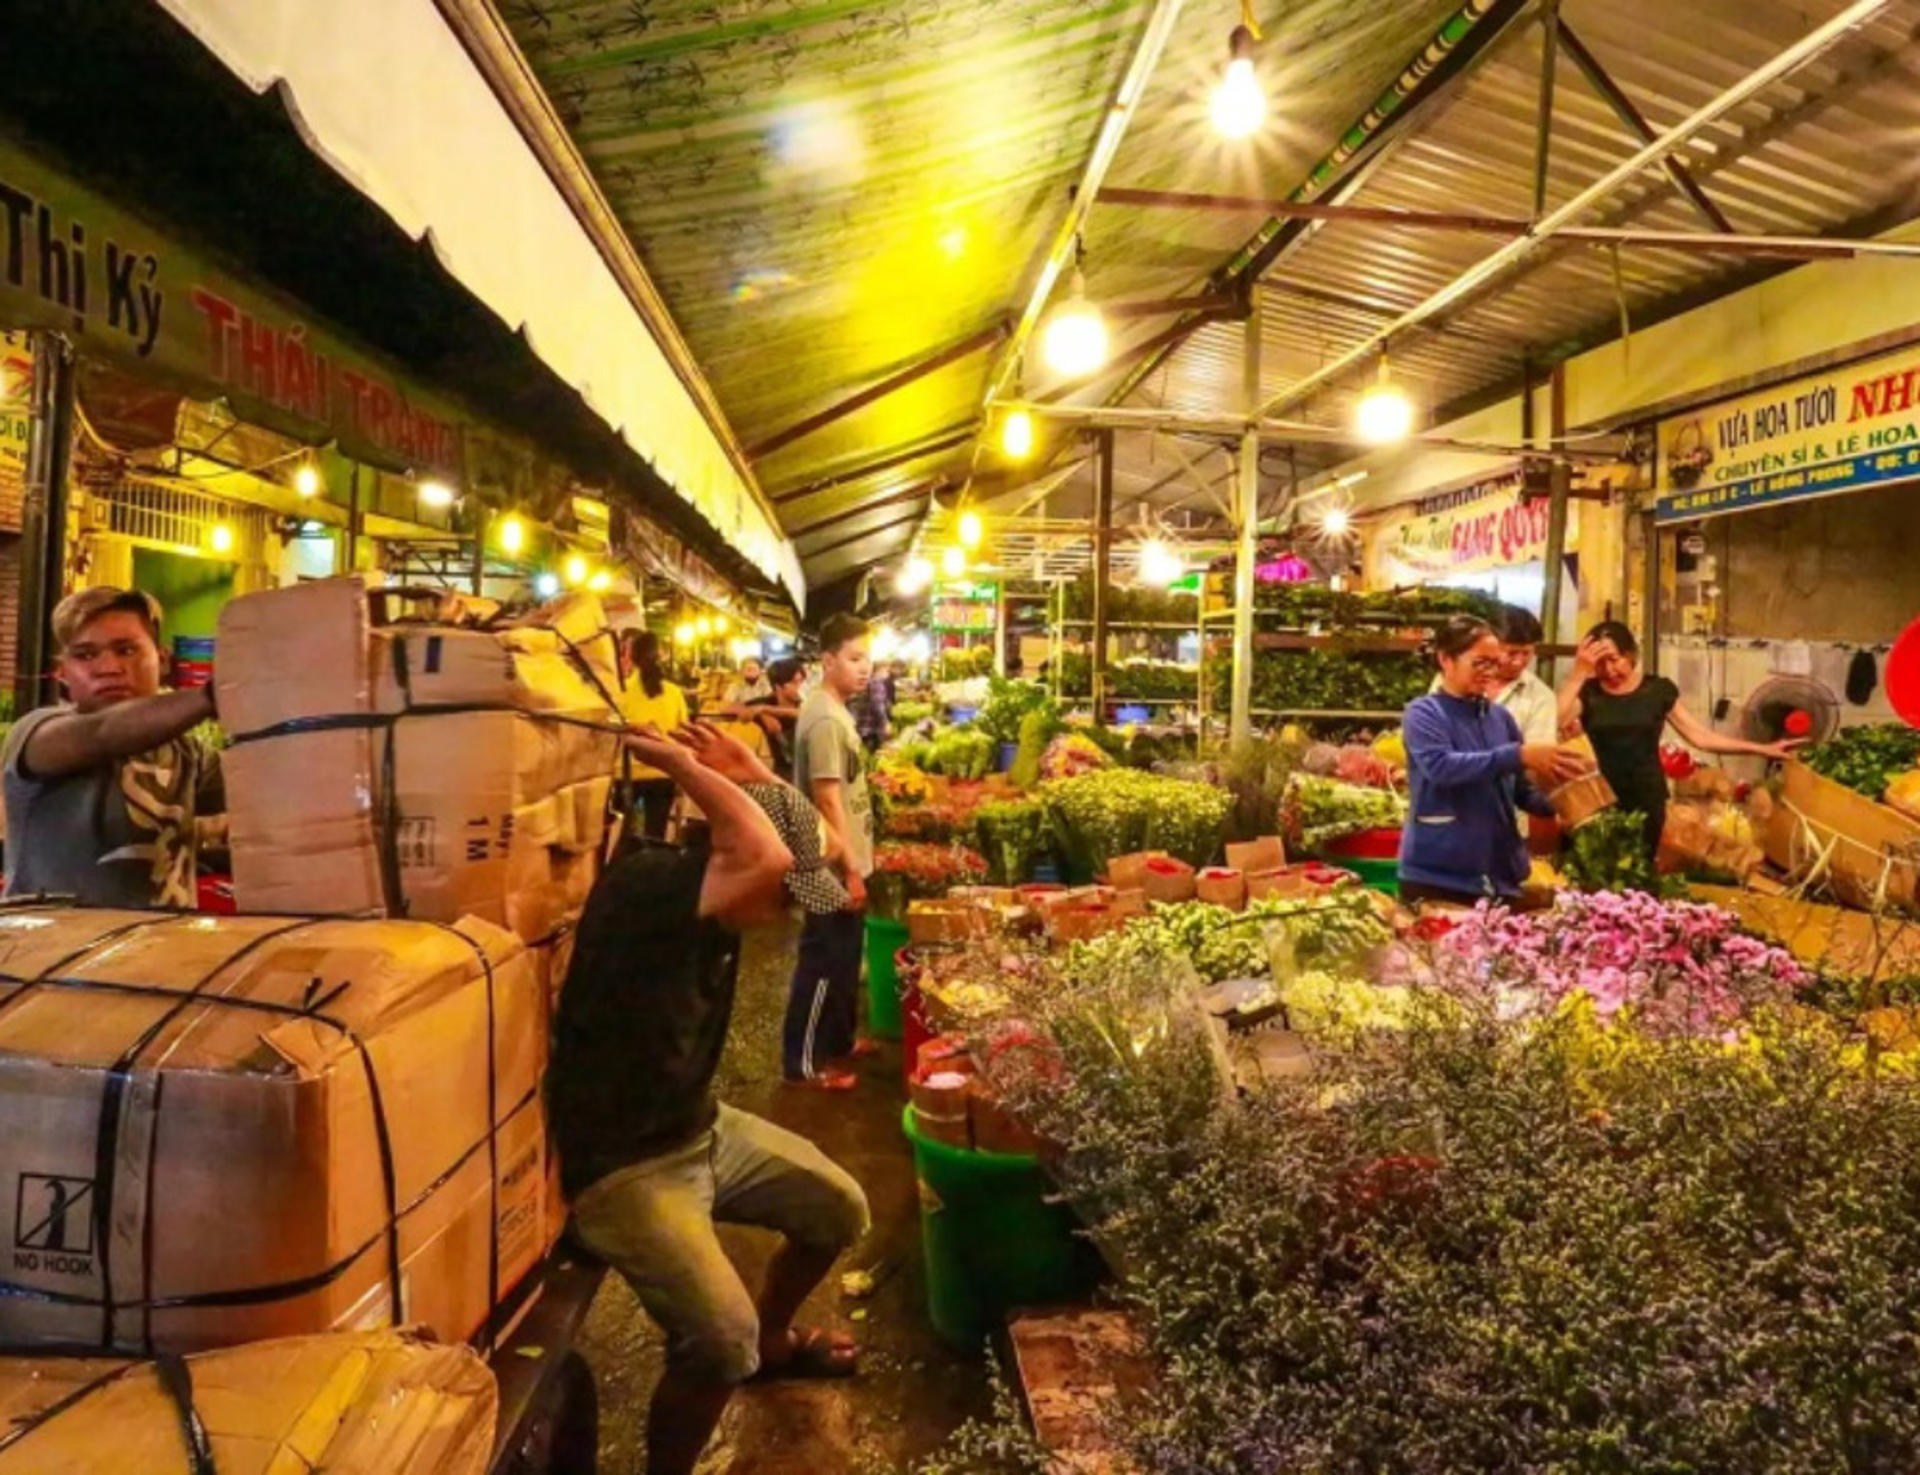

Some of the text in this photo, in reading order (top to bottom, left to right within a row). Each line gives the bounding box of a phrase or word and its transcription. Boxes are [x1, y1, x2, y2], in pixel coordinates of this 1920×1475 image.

[0, 182, 162, 357] Thị Kỷ
[1754, 401, 1788, 442] HOA
[1846, 367, 1920, 423] NH
[1814, 443, 1829, 460] &
[1868, 423, 1918, 449] HOA
[14, 1252, 93, 1276] NO HOOK
